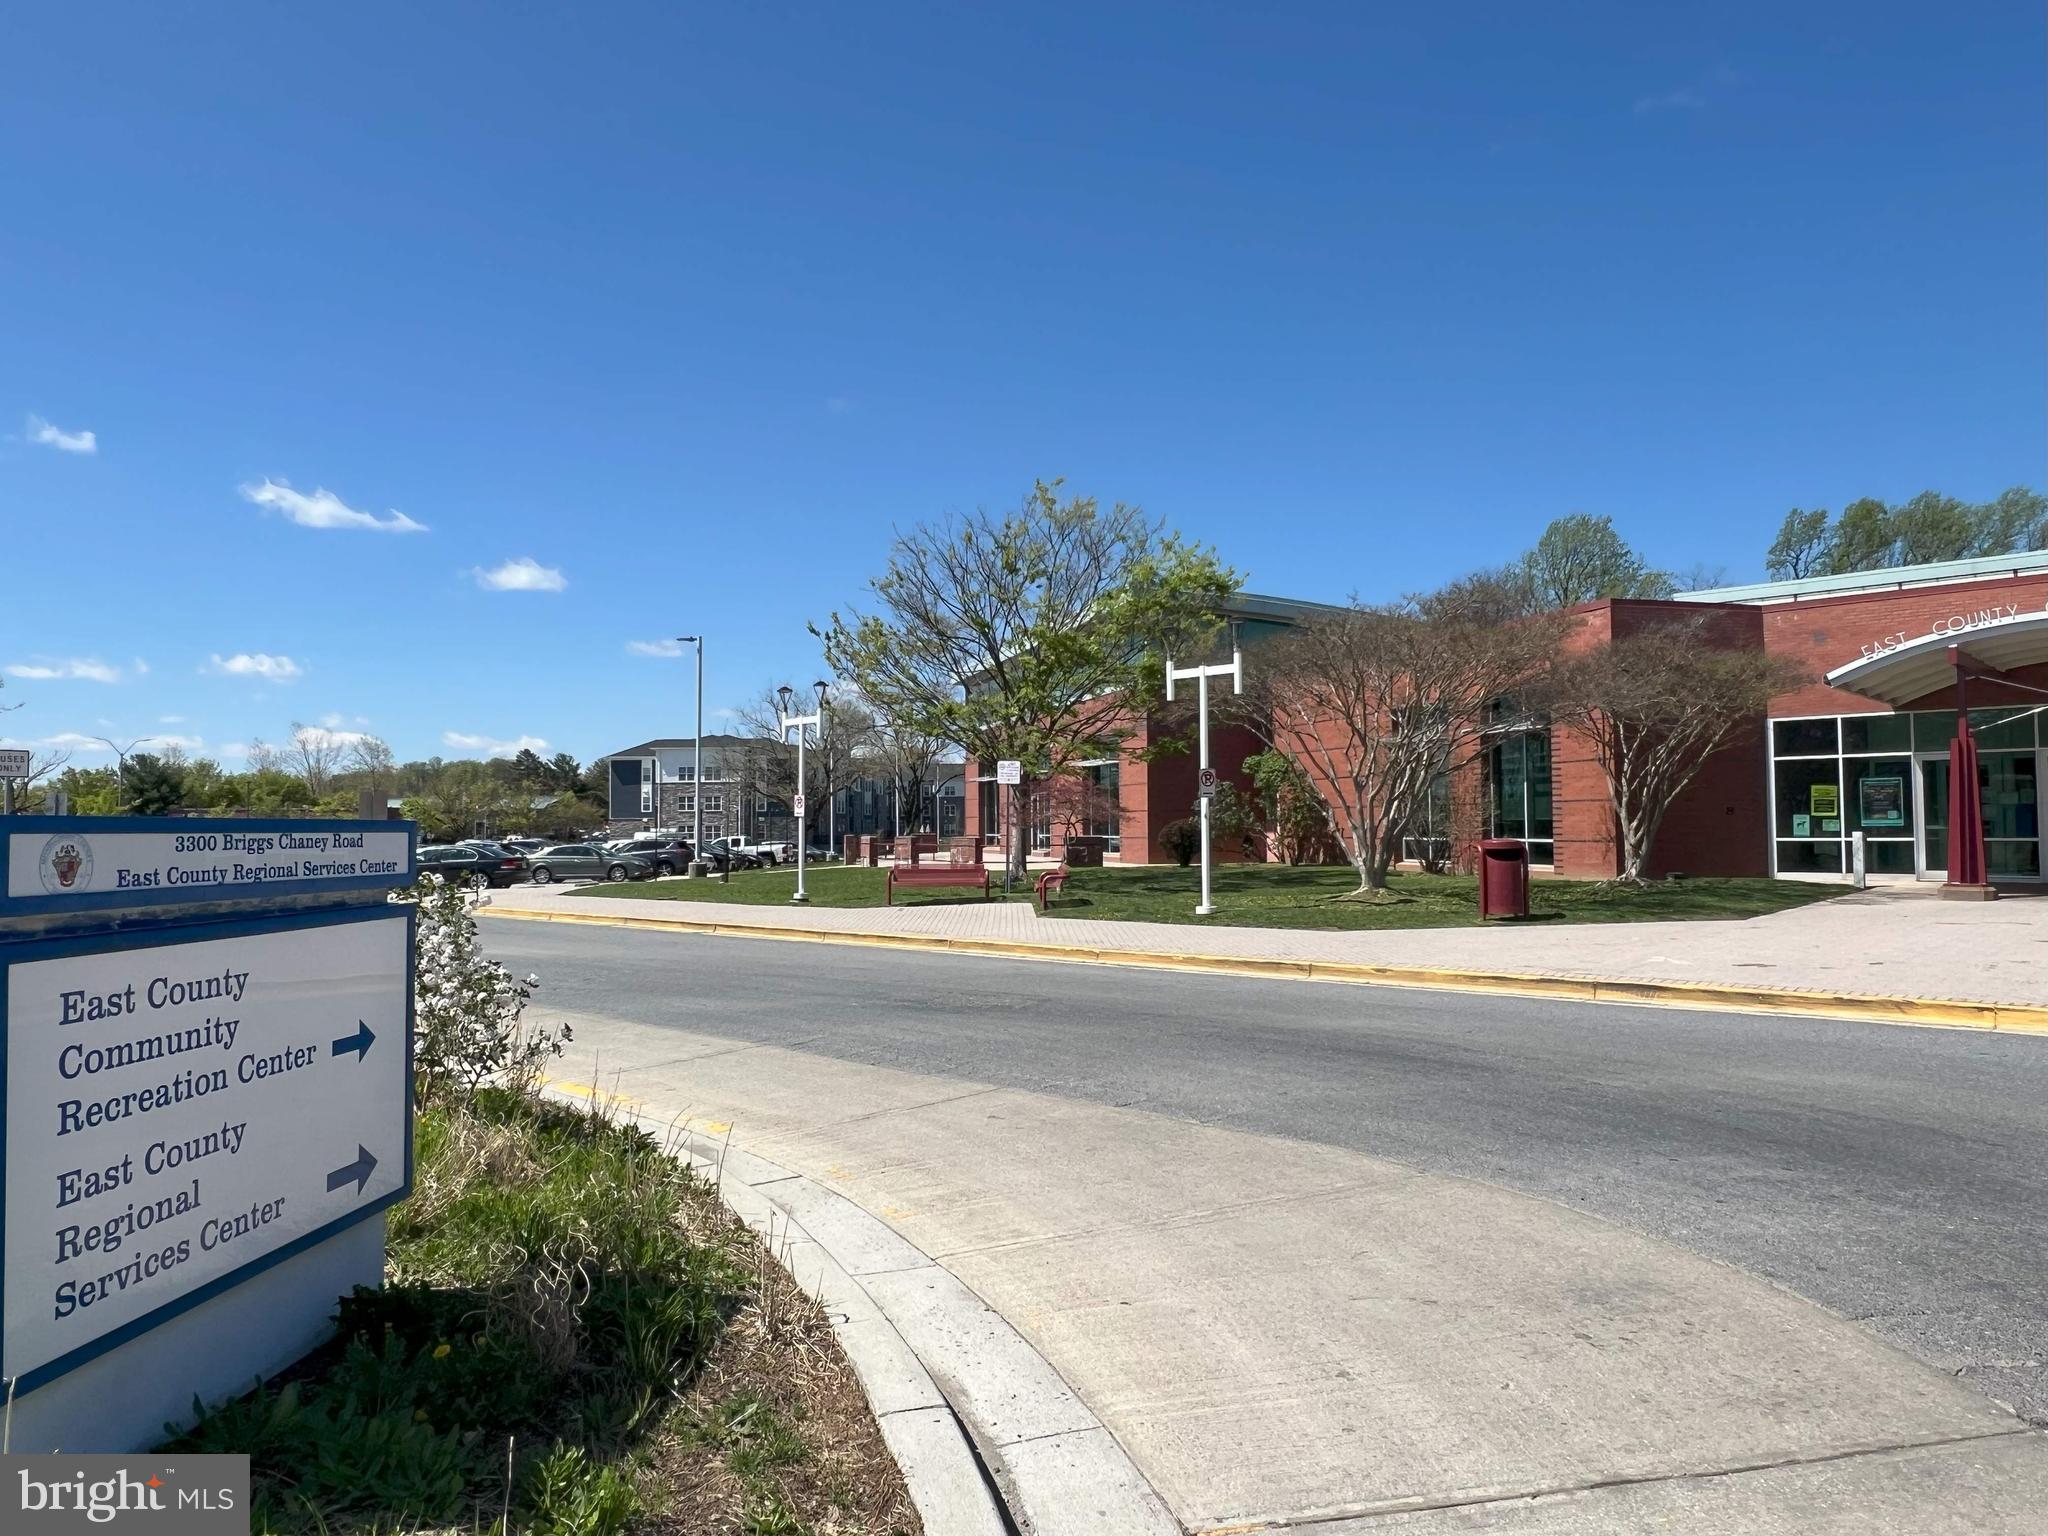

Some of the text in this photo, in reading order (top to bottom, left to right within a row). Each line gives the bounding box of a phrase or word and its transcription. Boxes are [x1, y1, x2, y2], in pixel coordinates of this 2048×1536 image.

[1860, 604, 2018, 659] EAST COUNTY
[116, 858, 398, 888] East County Regional Services Center
[175, 833, 364, 855] 3300 Briggs Chaney Road
[58, 967, 250, 1026] East County
[57, 1015, 241, 1080] Community
[56, 1042, 318, 1137] Recreation Center
[55, 1119, 248, 1209] East County
[54, 1180, 202, 1265] Regional
[54, 1195, 287, 1321] Services Center
